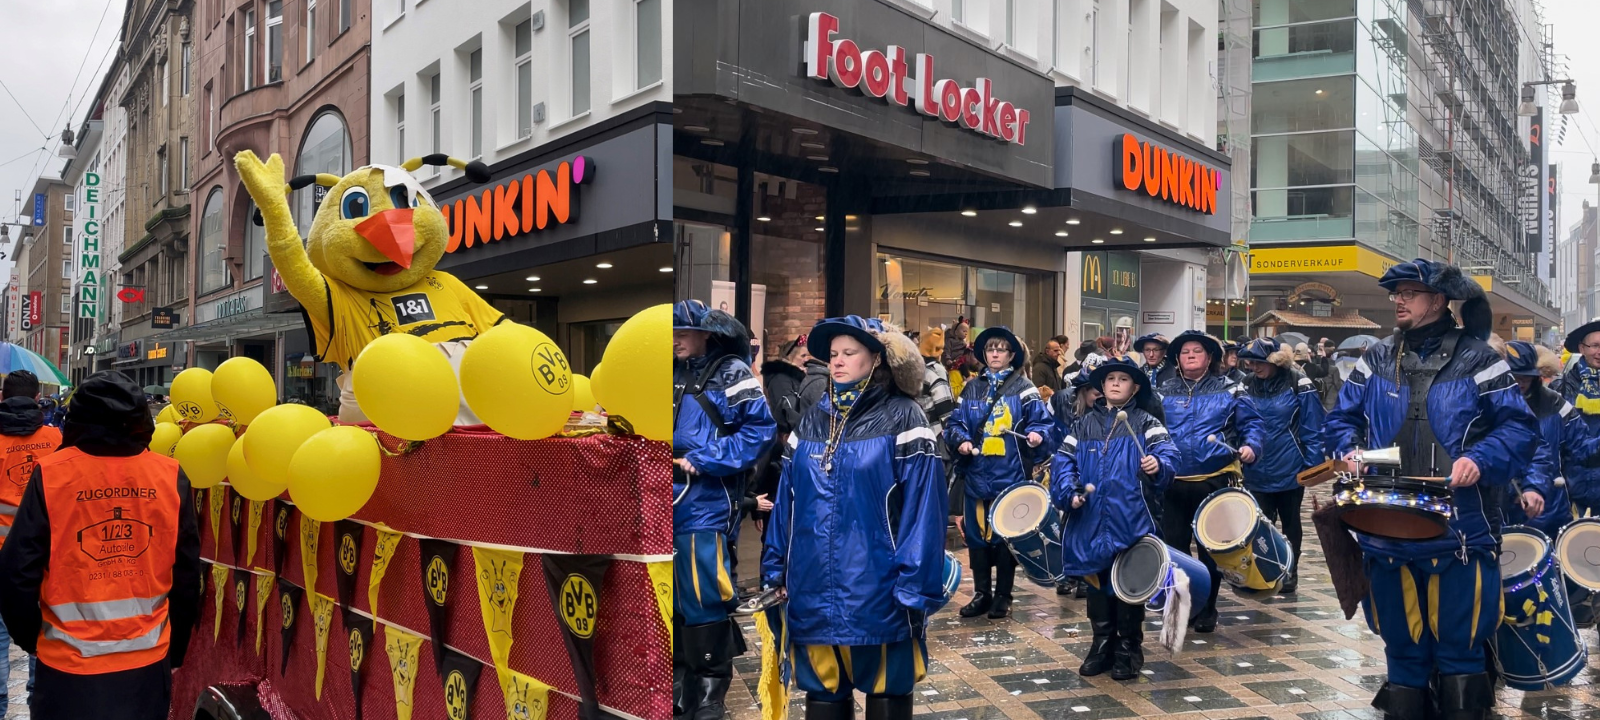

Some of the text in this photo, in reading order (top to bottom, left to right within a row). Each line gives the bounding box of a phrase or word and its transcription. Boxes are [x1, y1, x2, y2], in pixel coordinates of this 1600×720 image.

[807, 12, 1030, 146] Foot Locker
[1122, 133, 1222, 216] DUNKIN'
[441, 155, 586, 254] UNKIN'
[81, 172, 100, 318] DEICHMANN
[1256, 258, 1344, 269] SONDERVERKAUF
[22, 296, 31, 330] ONLY
[396, 299, 429, 317] 1&1
[537, 347, 567, 386] BVB
[6, 442, 52, 454] ZUGORDNER
[76, 487, 157, 501] ZUGORDNER
[101, 524, 133, 540] 1/2/3
[97, 558, 116, 568] GmbH
[431, 560, 447, 593] BVB
[565, 580, 594, 619] BVB
[575, 617, 589, 632] 09
